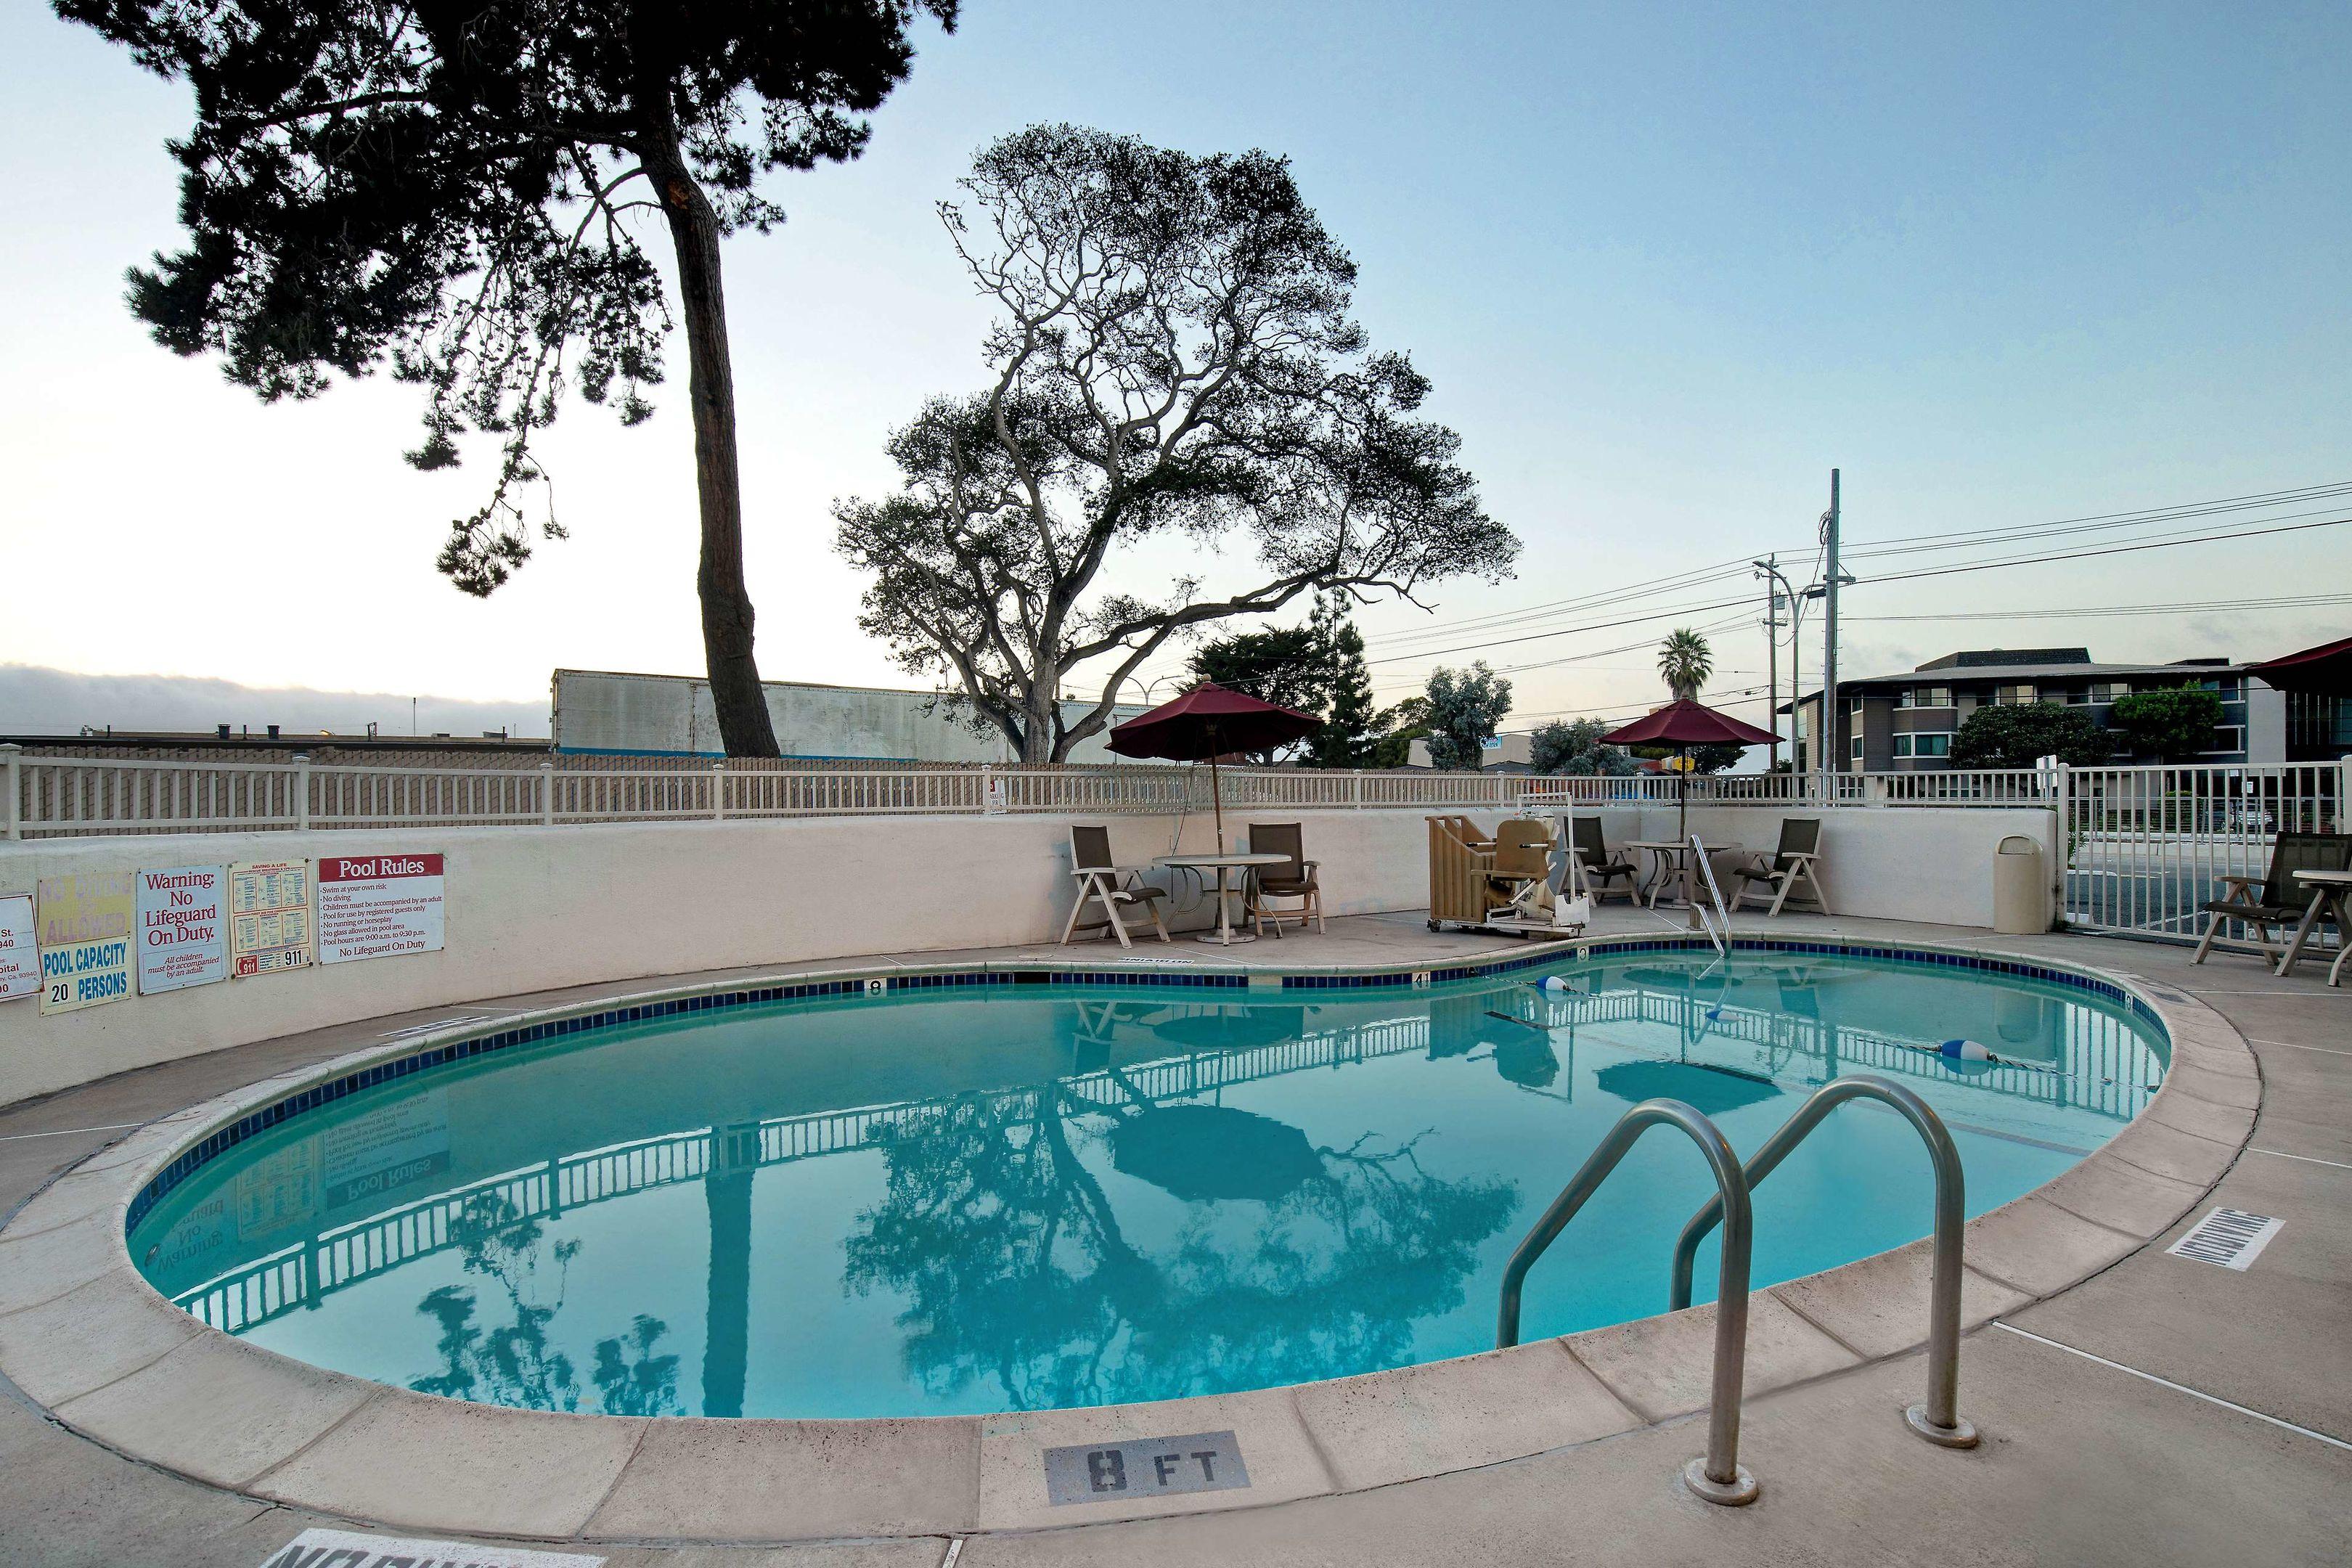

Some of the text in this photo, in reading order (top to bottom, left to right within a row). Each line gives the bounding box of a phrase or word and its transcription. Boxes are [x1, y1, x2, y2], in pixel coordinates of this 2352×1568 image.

[339, 858, 425, 878] Pool Rules
[145, 871, 215, 890] Warning:
[170, 891, 193, 907] No
[373, 898, 411, 907] accompanied
[146, 905, 216, 927] Lifeguard
[148, 930, 173, 946] On
[176, 926, 214, 943] Duty.
[340, 940, 425, 957] No Lifeguard On Duty
[44, 942, 126, 976] POOL CAPACITY
[147, 965, 165, 974] must
[176, 957, 220, 969] accompanied
[176, 953, 203, 962] children
[285, 950, 302, 966] 911
[186, 966, 204, 975] adult.
[244, 963, 255, 973] 911
[52, 971, 126, 1003] 20 PERSONS
[1087, 1450, 1216, 1492] 8 FT
